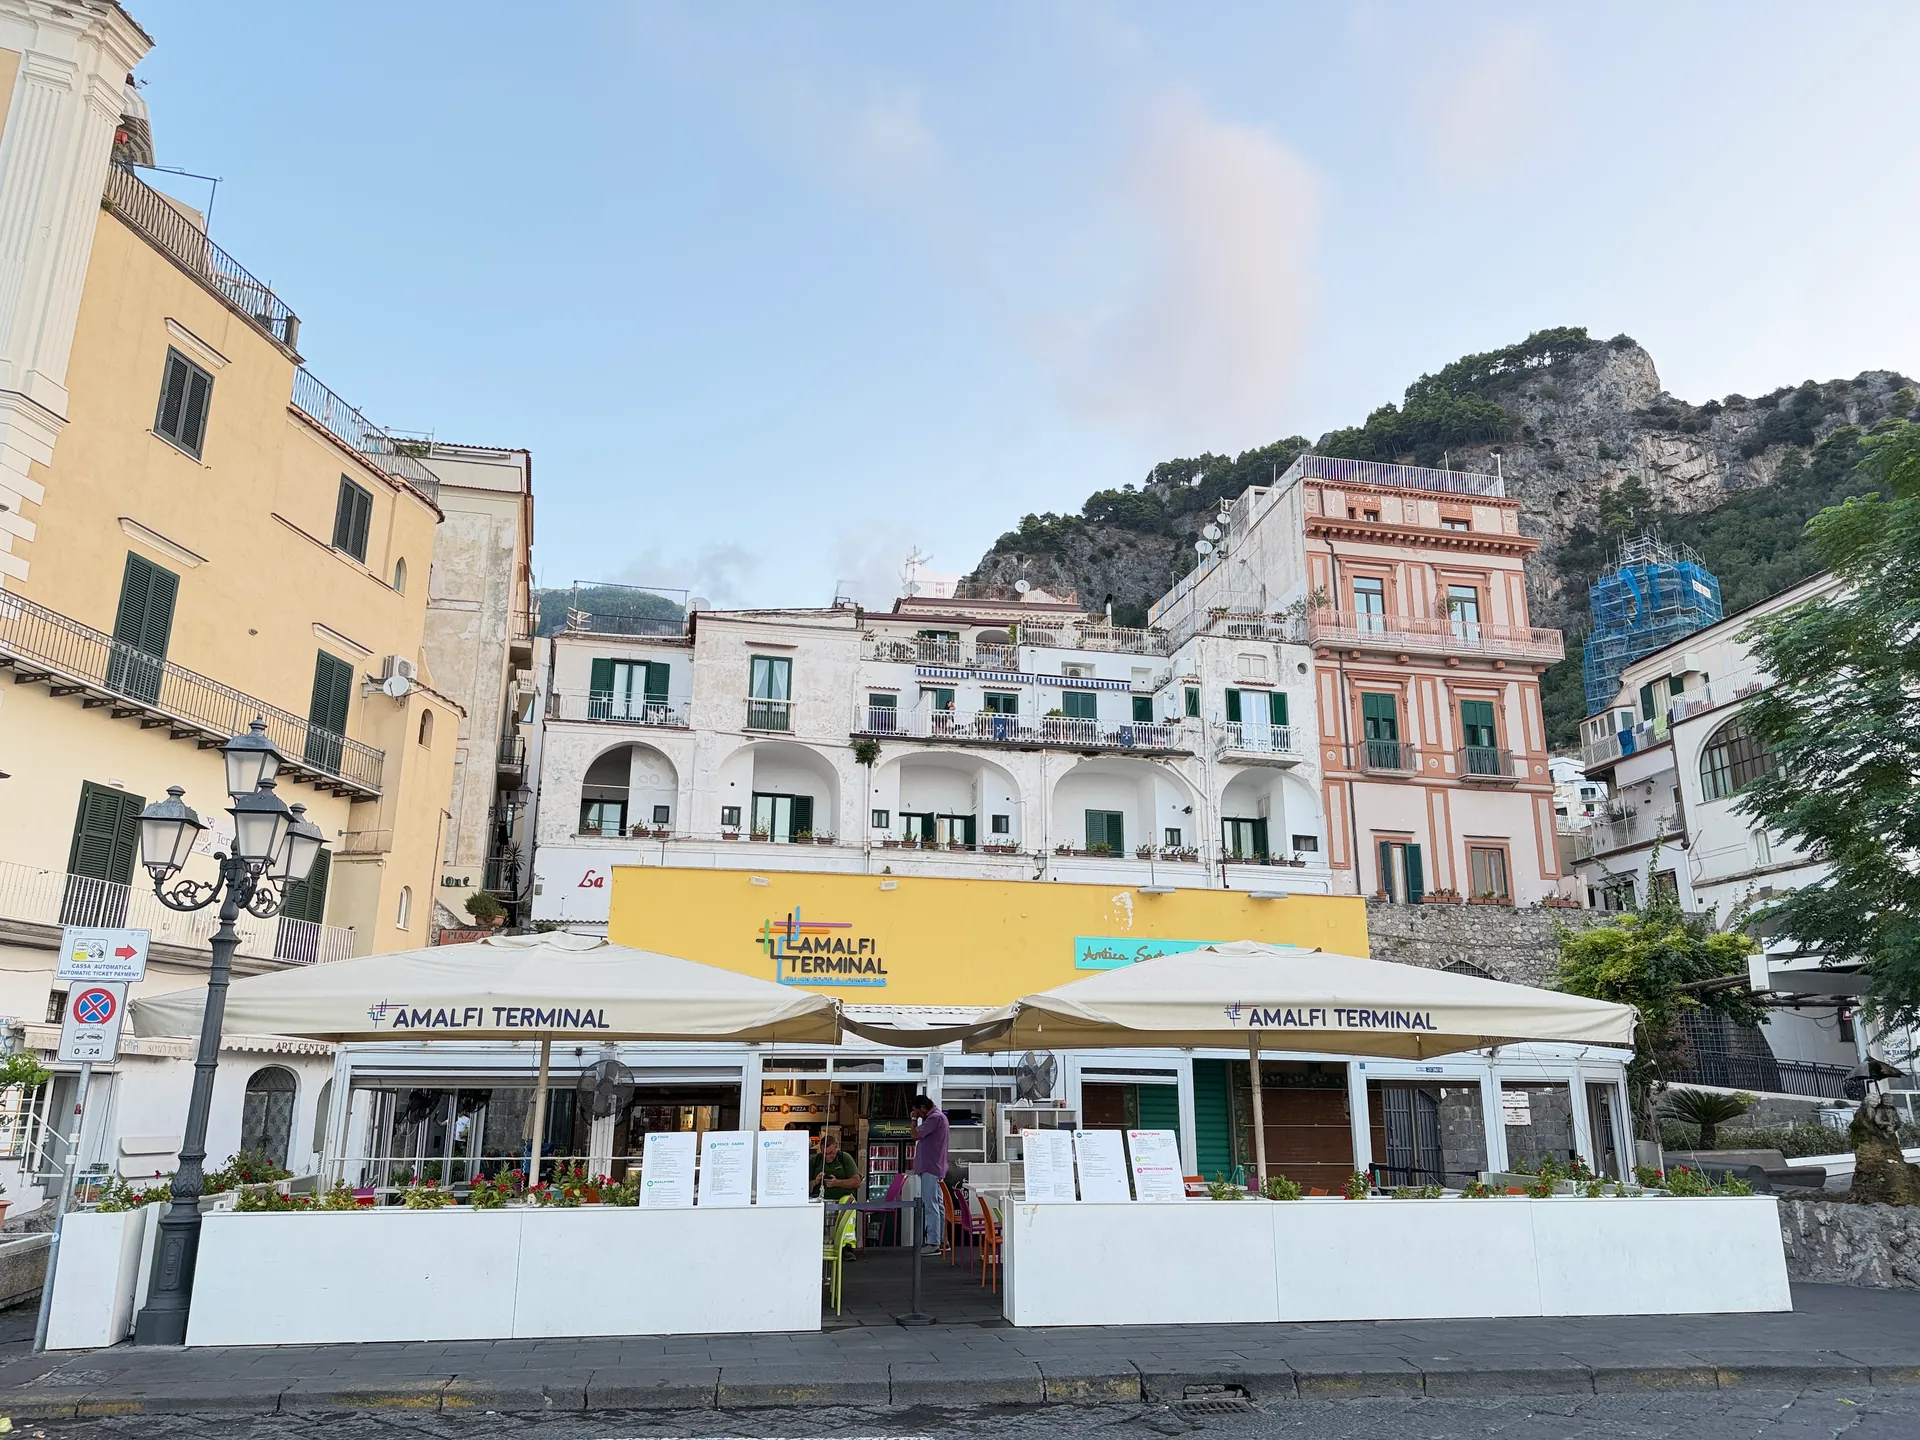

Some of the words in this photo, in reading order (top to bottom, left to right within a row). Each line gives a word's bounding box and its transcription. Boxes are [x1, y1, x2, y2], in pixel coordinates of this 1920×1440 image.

[578, 869, 604, 889] La
[798, 936, 876, 955] AMALFI
[791, 955, 888, 974] TERMINAL
[392, 1007, 484, 1029] AMALFI
[492, 1006, 611, 1029] TERMINAL
[1249, 1008, 1327, 1028] AMALFI
[1333, 1008, 1437, 1031] TERMINAL
[275, 1042, 293, 1050] ART
[298, 1043, 330, 1051] CENTRE
